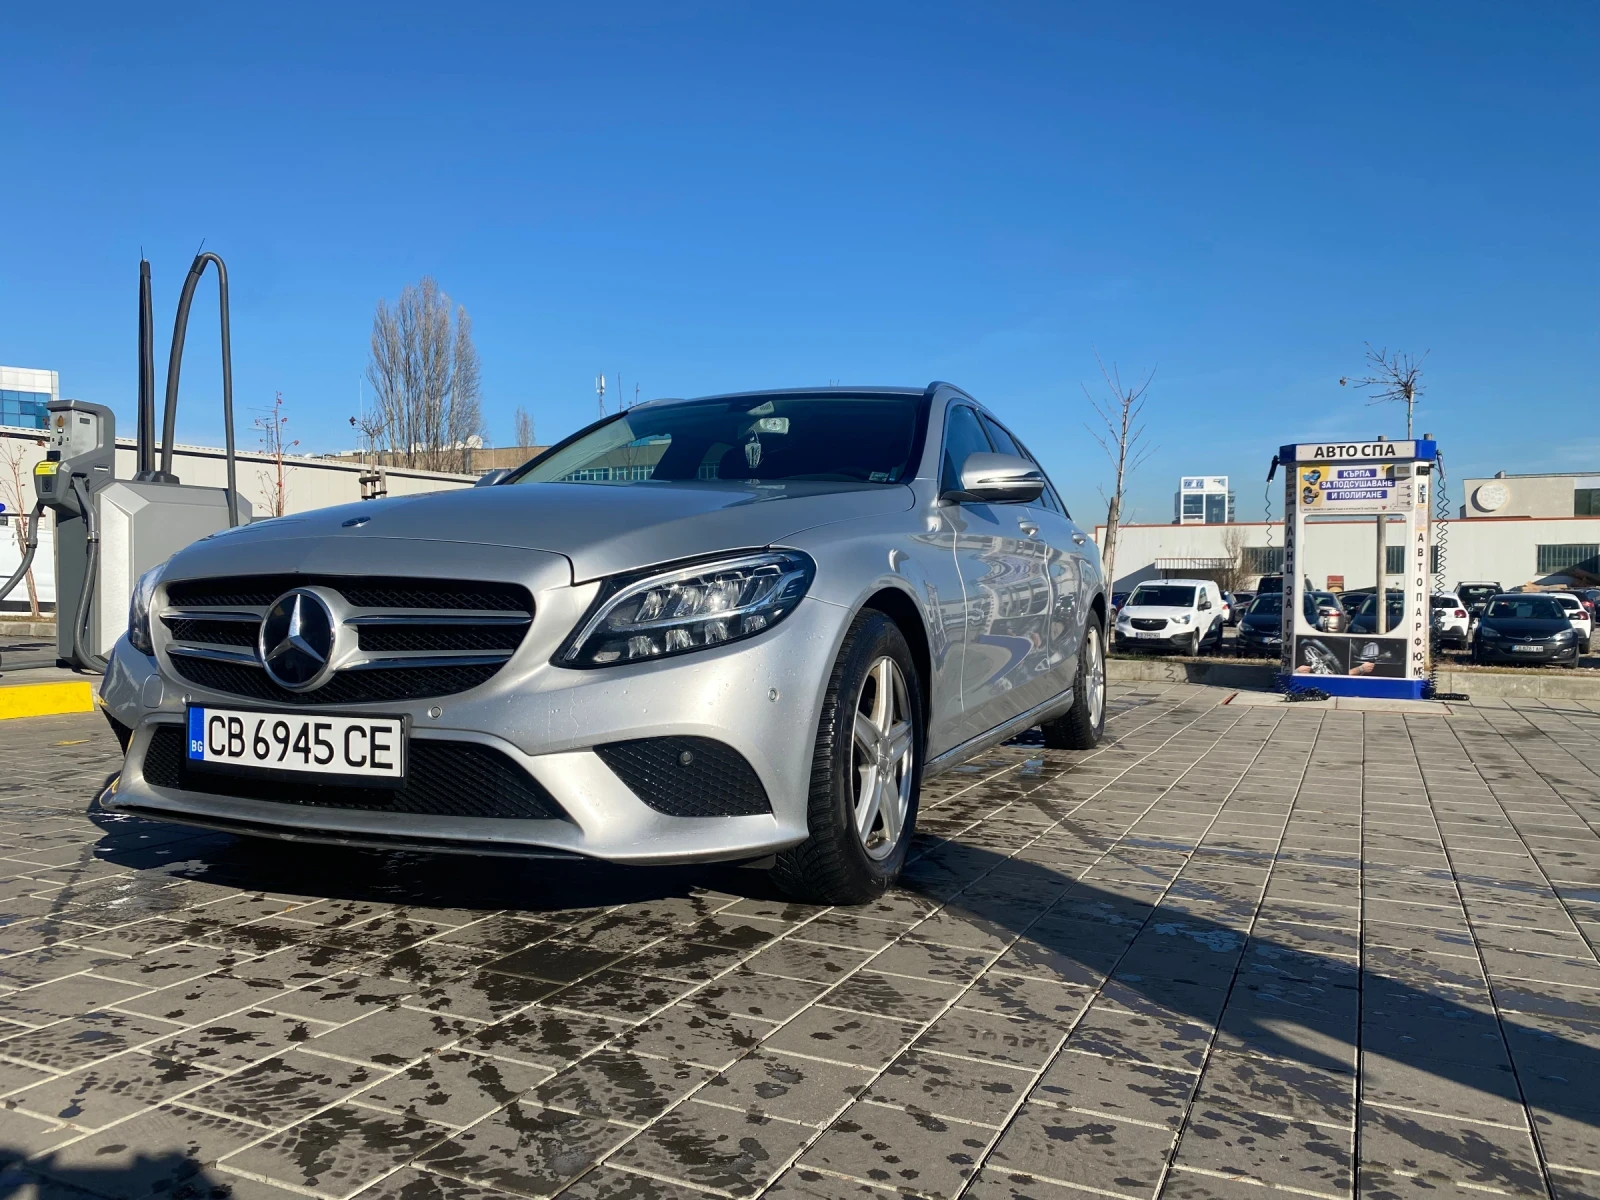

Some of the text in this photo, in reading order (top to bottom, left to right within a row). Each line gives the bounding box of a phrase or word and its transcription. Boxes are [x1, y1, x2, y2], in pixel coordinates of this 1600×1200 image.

[1314, 444, 1396, 458] АВТО СПА
[1343, 470, 1370, 478] КЪРПА
[1335, 480, 1393, 489] ПОДСУШАВАНЕ
[1339, 491, 1382, 499] ПОЛИРАНЕ
[1286, 513, 1294, 575] ГЛАНЦ
[1286, 586, 1293, 609] ЗА
[1413, 533, 1424, 676] АВТОПАРФЮМ
[191, 740, 203, 753] BG
[208, 715, 393, 770] CB 6945 CE
